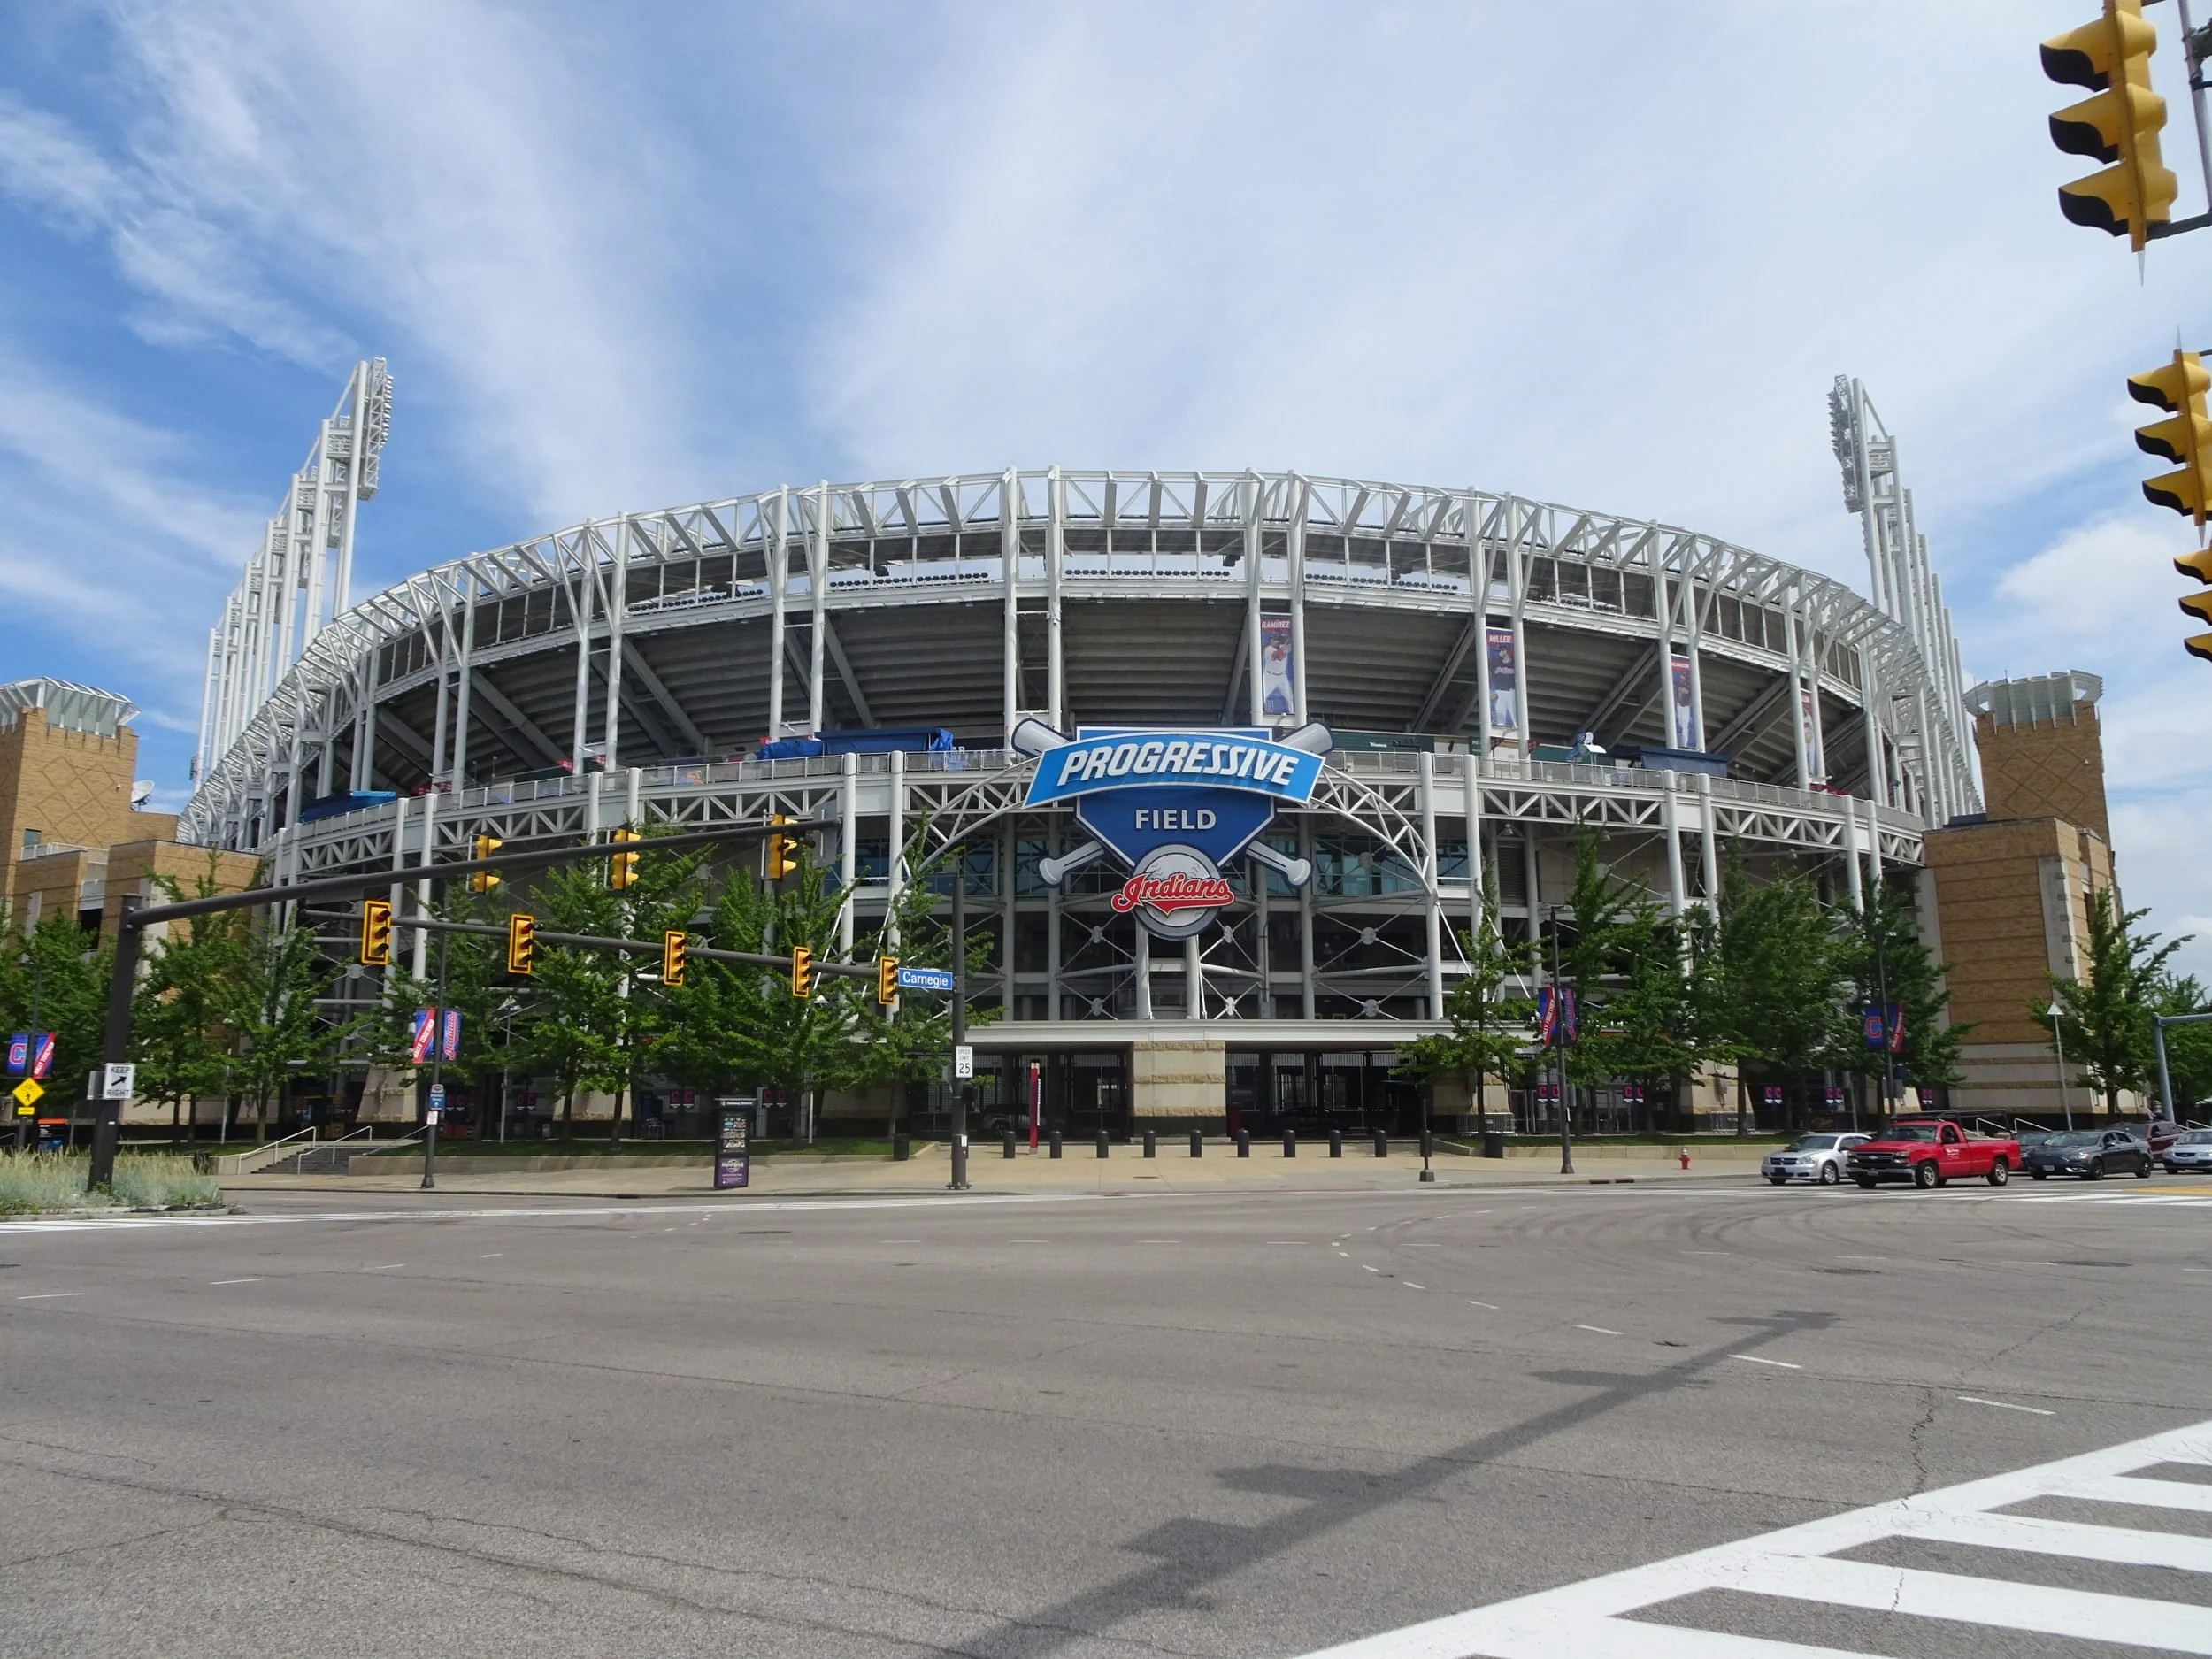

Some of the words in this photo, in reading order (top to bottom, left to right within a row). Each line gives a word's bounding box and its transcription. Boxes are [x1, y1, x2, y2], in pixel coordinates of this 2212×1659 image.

[1262, 620, 1290, 629] RAMÍREZ
[1489, 634, 1511, 643] MILLER
[1056, 741, 1301, 787] PROGRESSIVE
[1135, 810, 1217, 830] FIELD
[1110, 872, 1235, 918] Indians
[902, 972, 949, 987] Carnegie
[444, 1010, 458, 1061] Indians
[1864, 1016, 1883, 1039] C
[9, 1043, 27, 1064] C
[959, 1063, 971, 1074] 25
